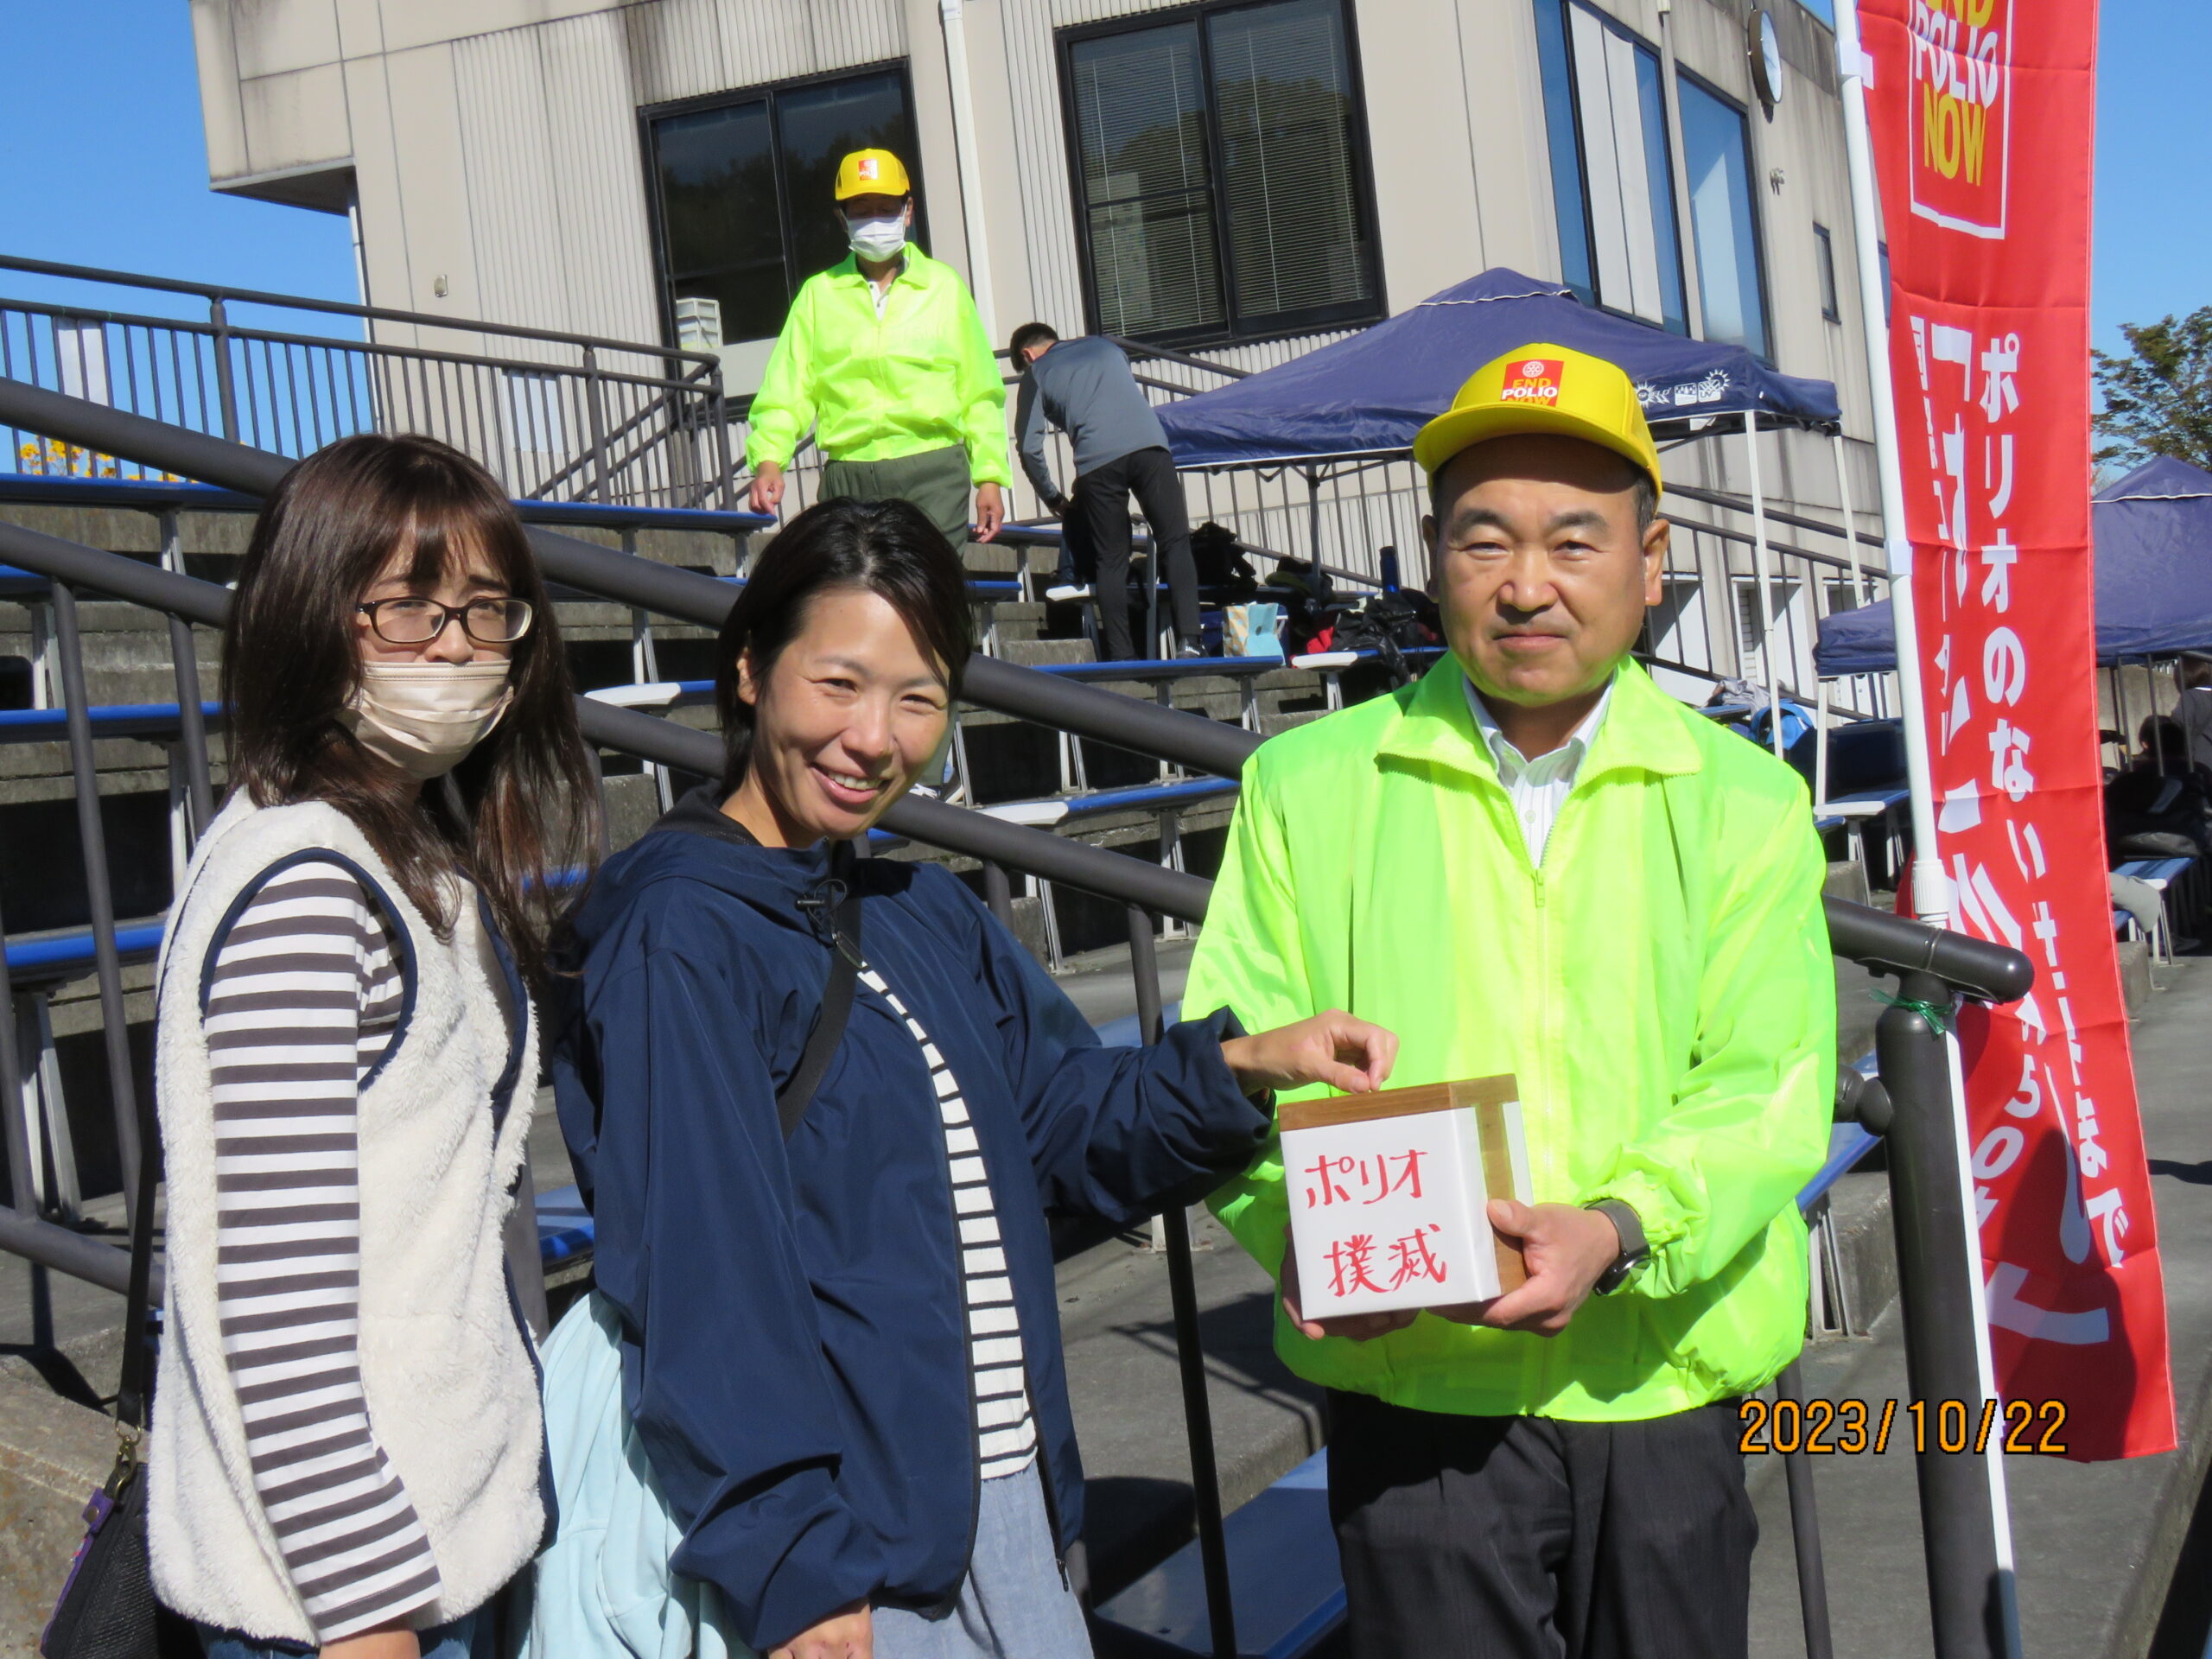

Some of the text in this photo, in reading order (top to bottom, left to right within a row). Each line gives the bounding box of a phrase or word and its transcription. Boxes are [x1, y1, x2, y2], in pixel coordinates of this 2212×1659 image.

[1923, 82, 1986, 187] NOW
[1501, 386, 1558, 400] POLIO
[1512, 378, 1552, 389] END
[1304, 1148, 1428, 1209] ポリオ
[1323, 1224, 1448, 1298] 撲滅
